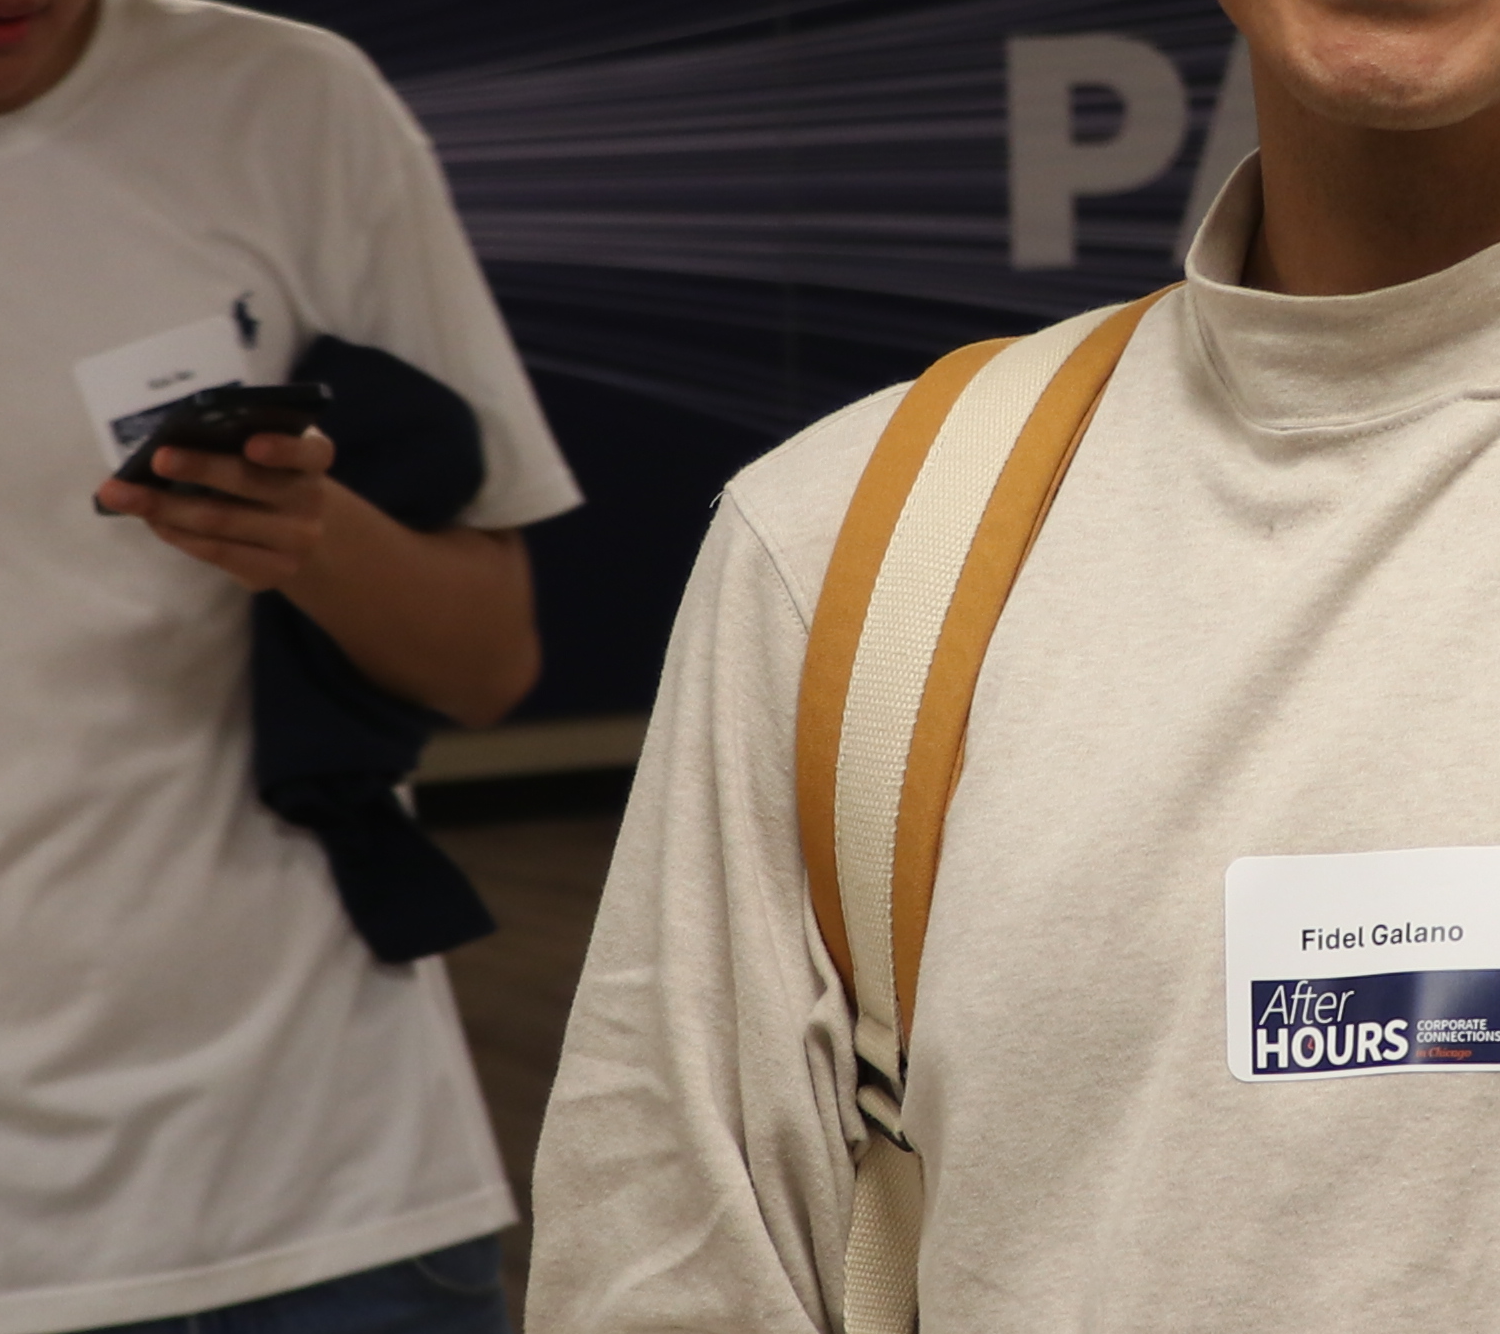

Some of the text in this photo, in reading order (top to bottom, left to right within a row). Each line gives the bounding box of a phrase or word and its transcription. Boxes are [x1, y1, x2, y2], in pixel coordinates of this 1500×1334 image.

[1301, 922, 1464, 951] Fidel Galano
[1258, 980, 1355, 1025] After
[1416, 1018, 1488, 1031] CORPORATE
[1256, 1018, 1409, 1069] HOURS
[1428, 1045, 1473, 1060] Chicago
